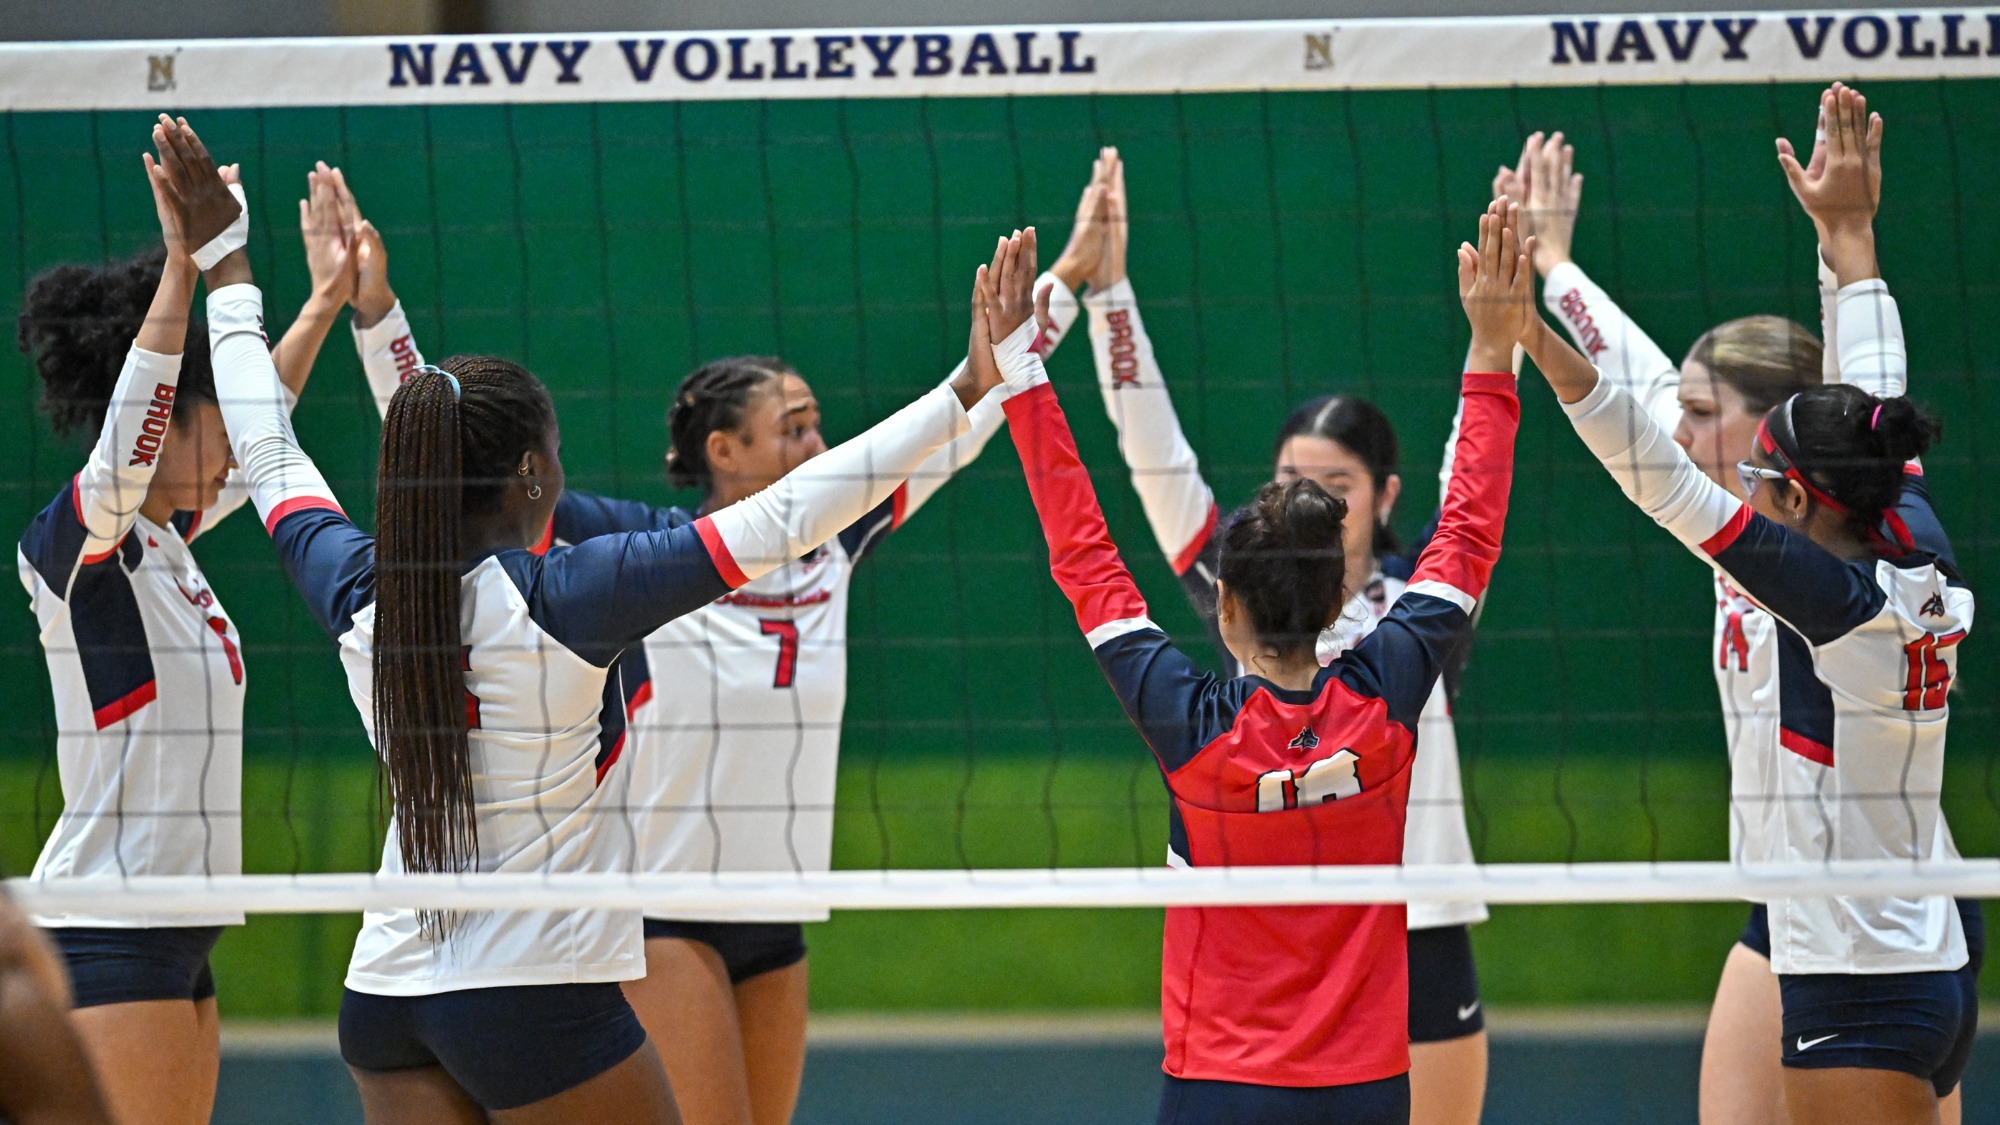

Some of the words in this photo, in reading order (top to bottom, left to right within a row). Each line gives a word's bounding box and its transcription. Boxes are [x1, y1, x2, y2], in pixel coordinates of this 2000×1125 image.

[388, 42, 590, 86] NAVY
[618, 31, 1096, 82] VOLLEYBALL
[1550, 18, 1758, 64] NAVY
[1106, 309, 1142, 390] BROOK
[1560, 288, 1608, 356] BROOK
[128, 382, 177, 467] BROOK
[758, 617, 799, 688] 7
[1903, 630, 1968, 711] 15
